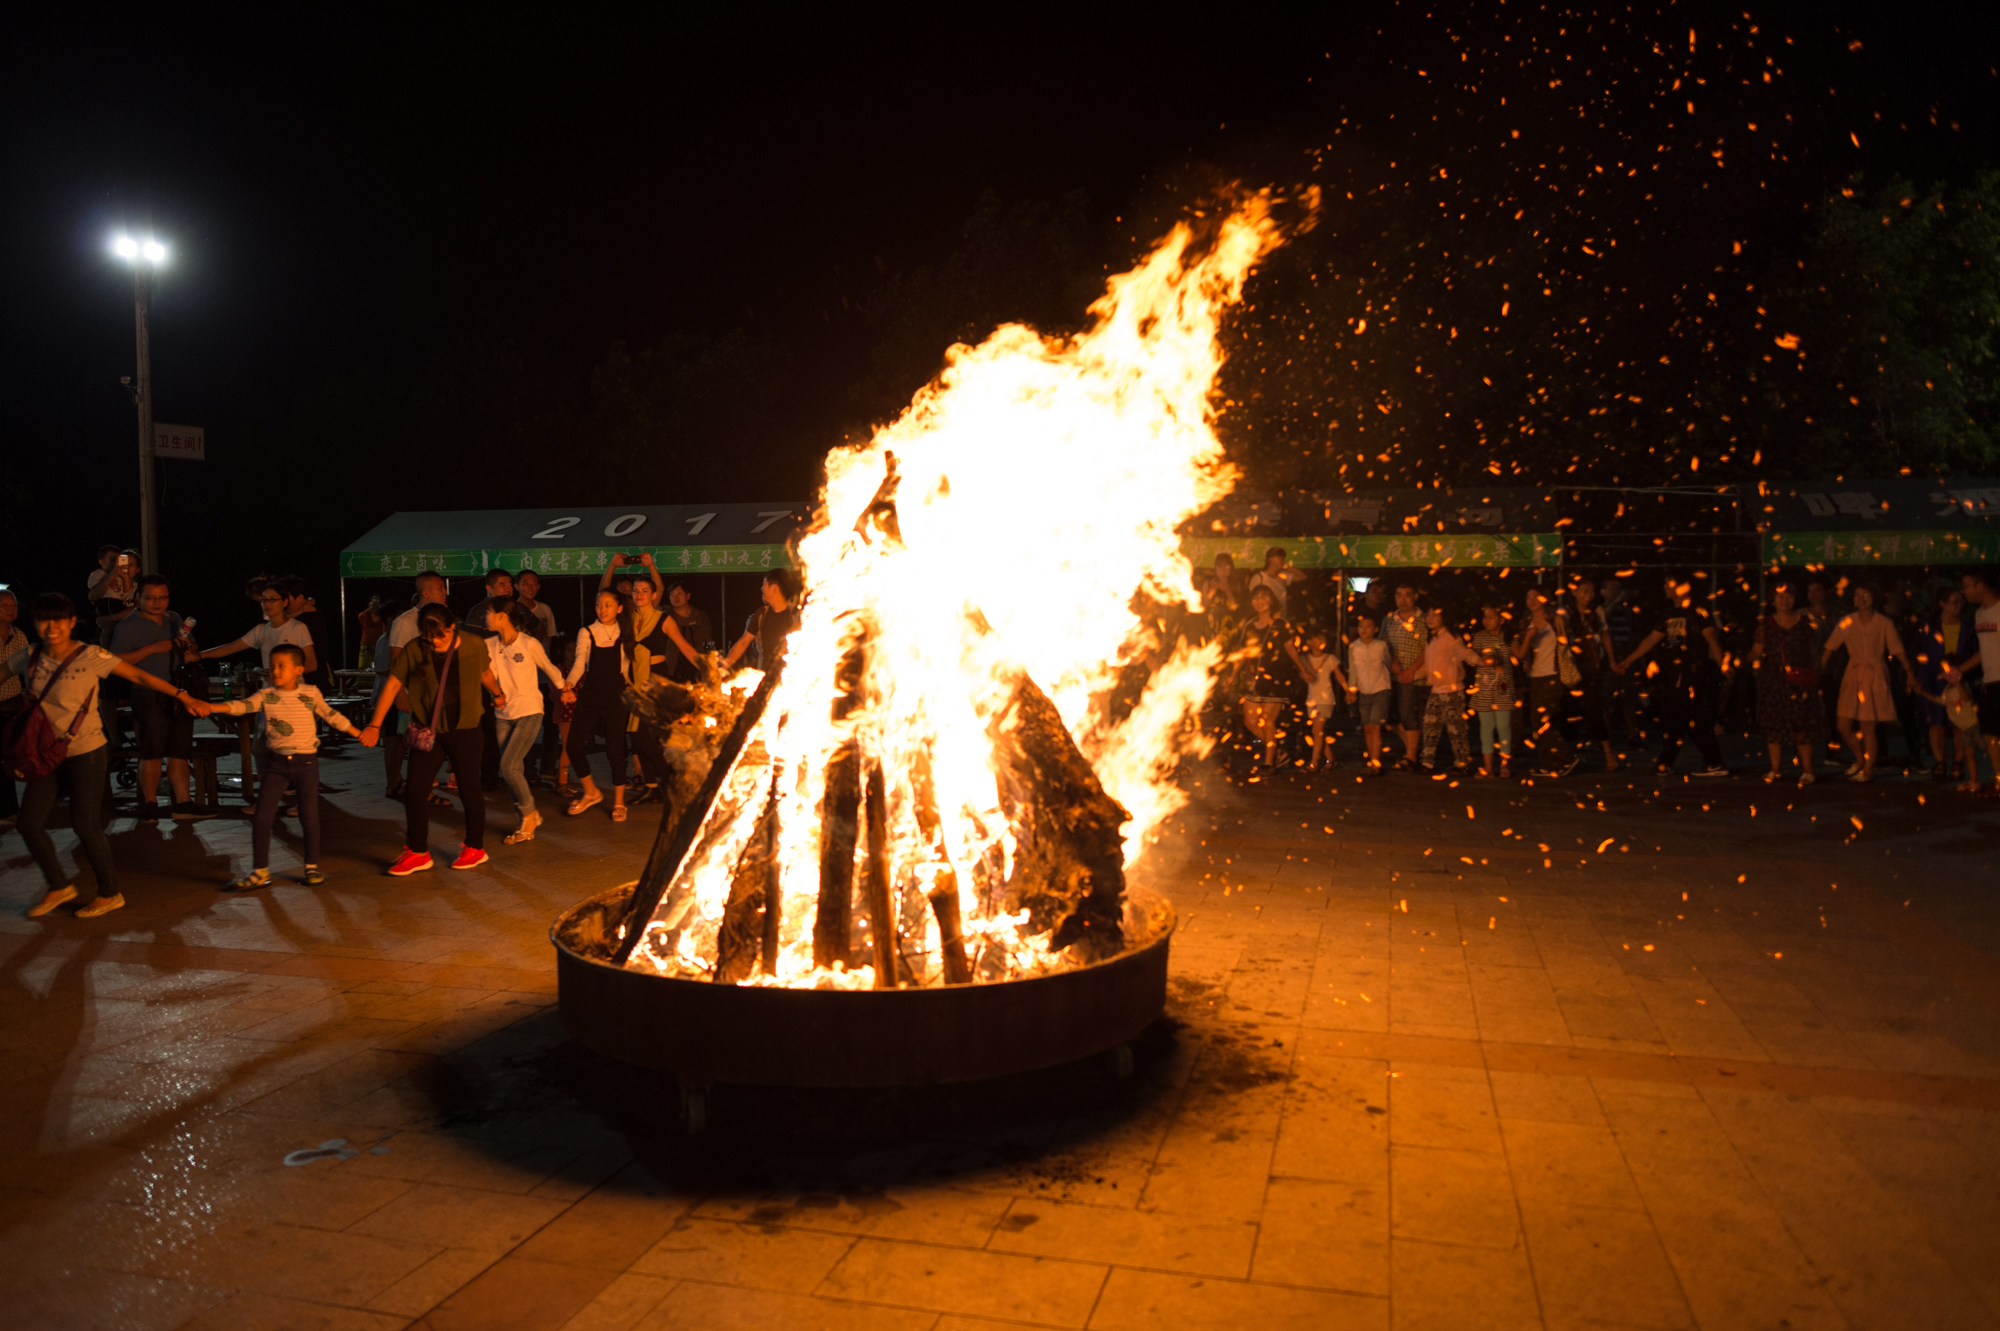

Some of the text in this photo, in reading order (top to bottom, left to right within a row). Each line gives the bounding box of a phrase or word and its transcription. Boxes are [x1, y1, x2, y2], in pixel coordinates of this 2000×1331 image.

[158, 435, 196, 451] 卫生间
[532, 510, 793, 539] 2017
[380, 553, 447, 572] 恋上卤味
[520, 550, 608, 573] 内蒙古大串
[677, 549, 772, 570] 章鱼小丸子
